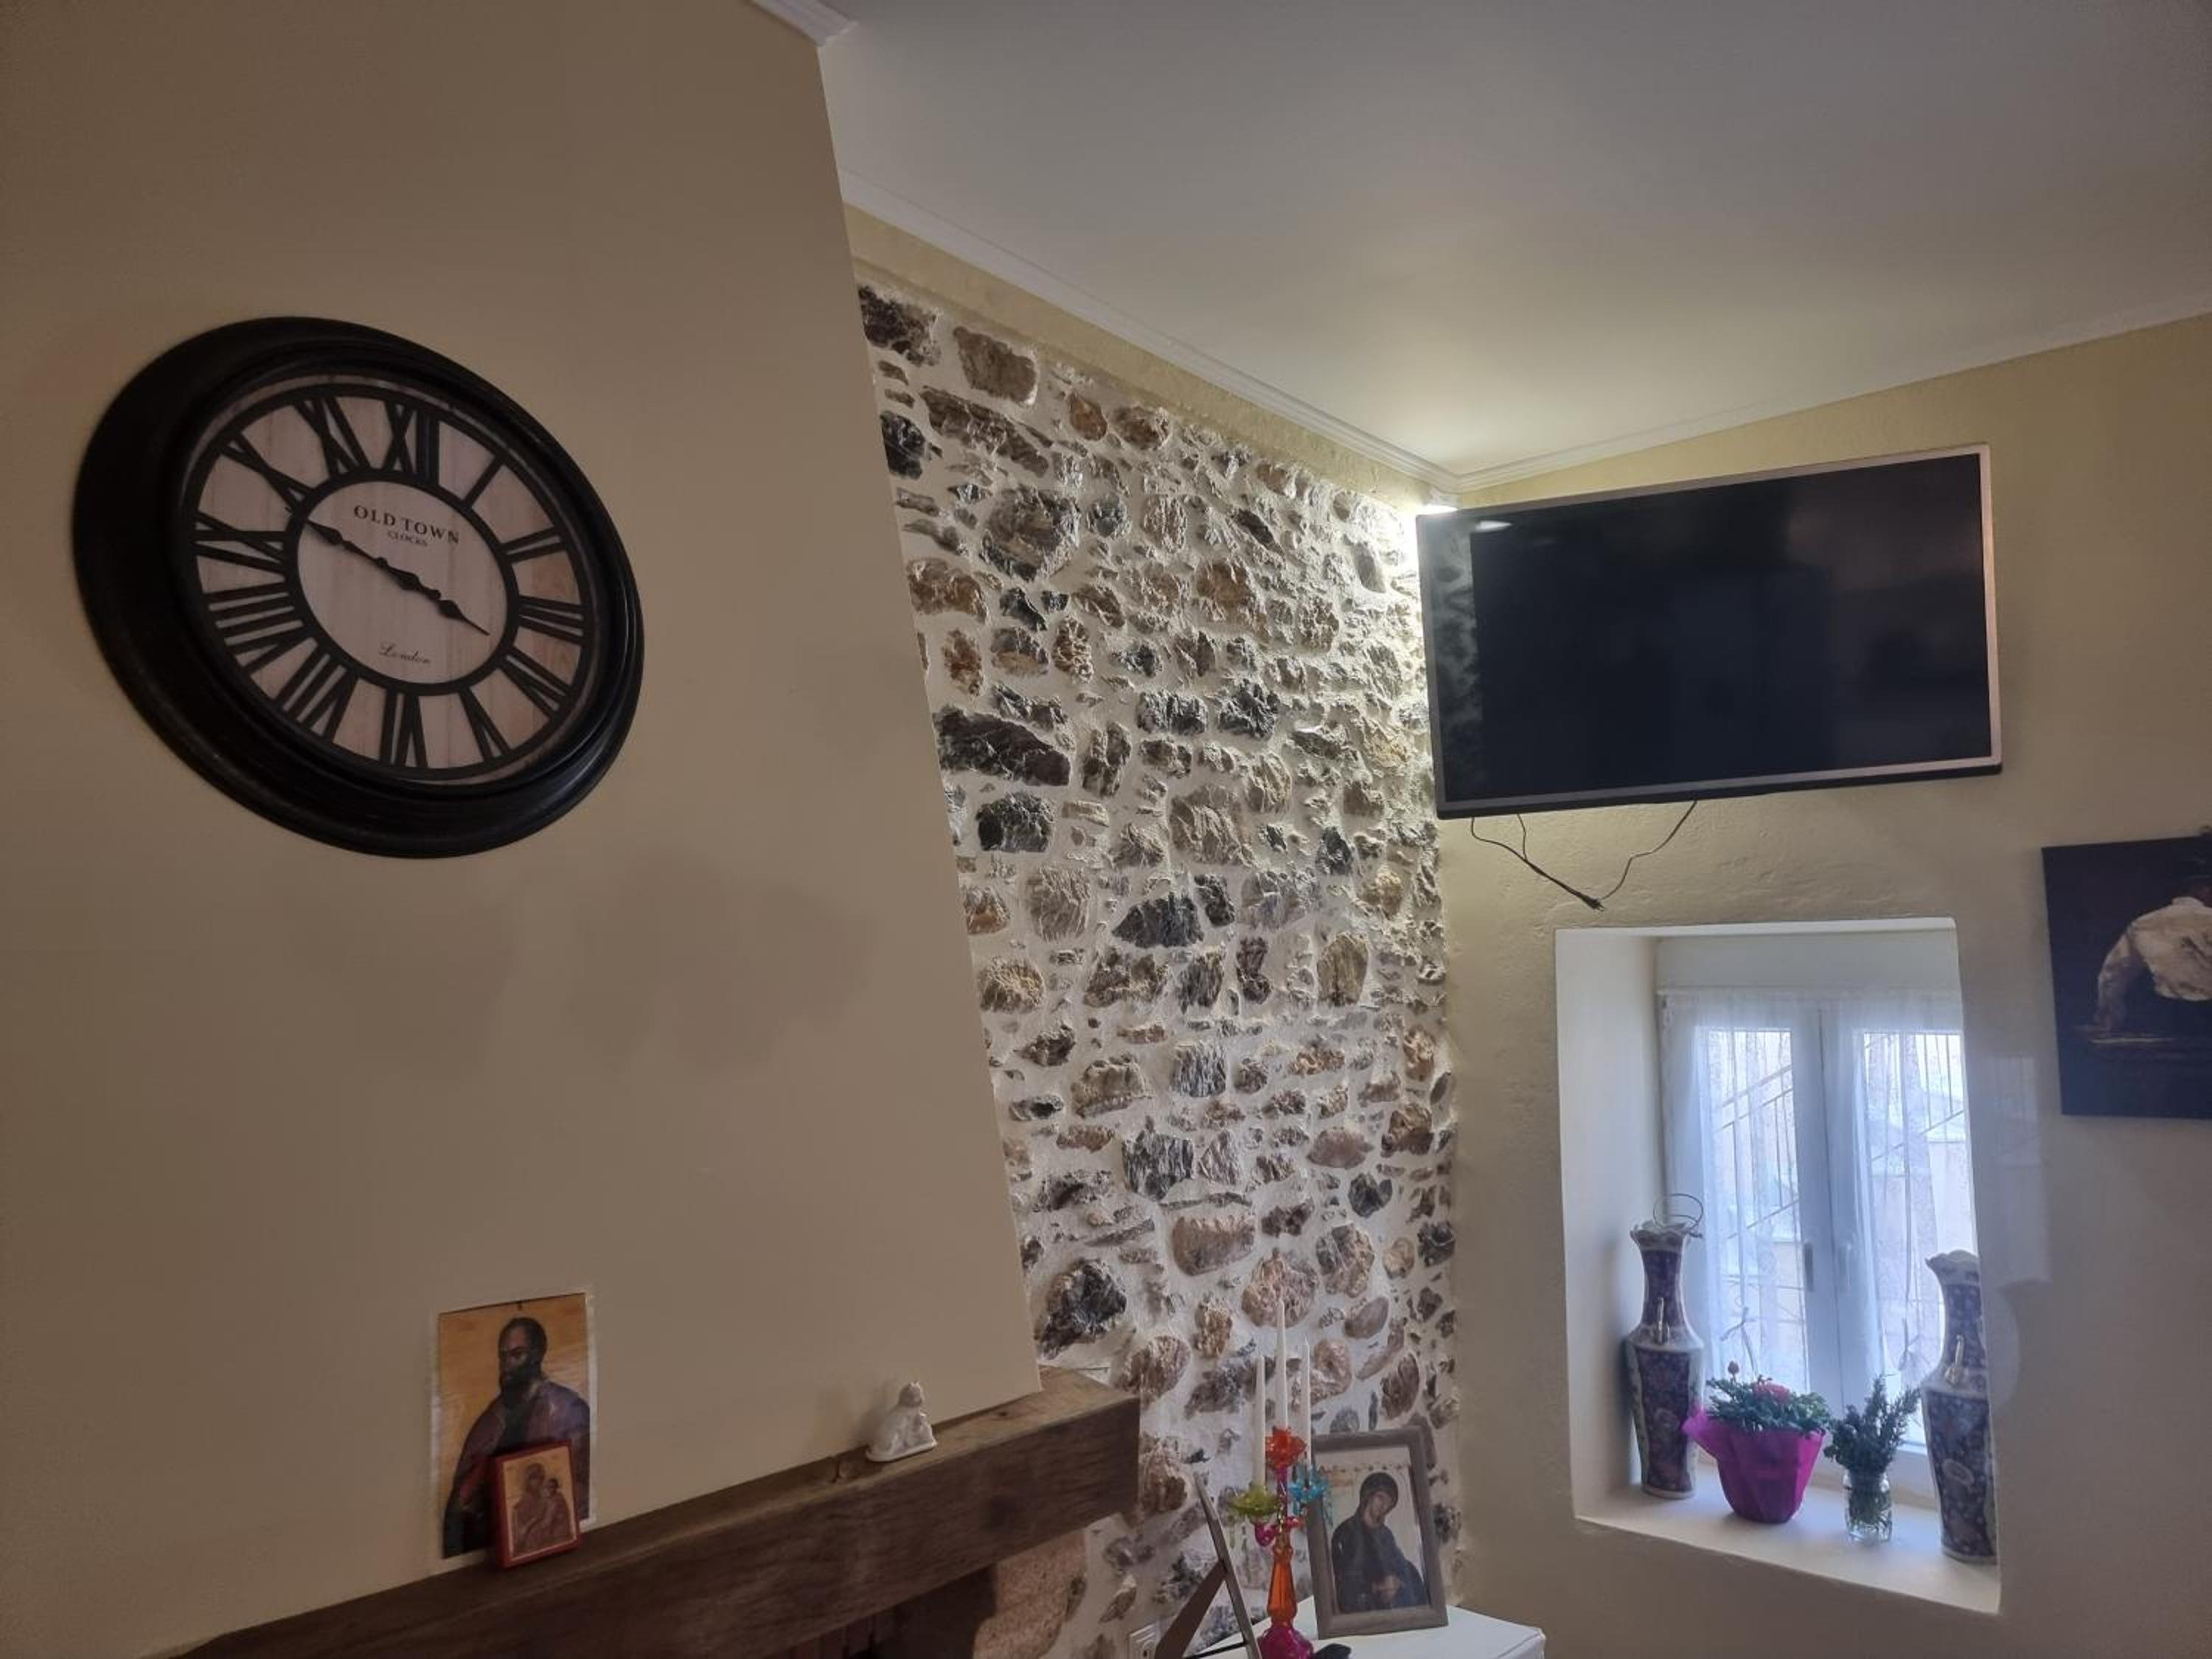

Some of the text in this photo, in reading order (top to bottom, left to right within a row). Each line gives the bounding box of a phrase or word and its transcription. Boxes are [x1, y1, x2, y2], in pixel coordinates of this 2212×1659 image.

[221, 433, 316, 514] X
[381, 402, 441, 484] XII
[354, 505, 459, 543] OLD TOWN
[387, 530, 428, 546] CLOCKS
[503, 526, 566, 565] II
[378, 639, 431, 664] London
[516, 596, 587, 647] III
[271, 640, 359, 742] VII
[378, 688, 430, 768] VI
[459, 688, 512, 762] V
